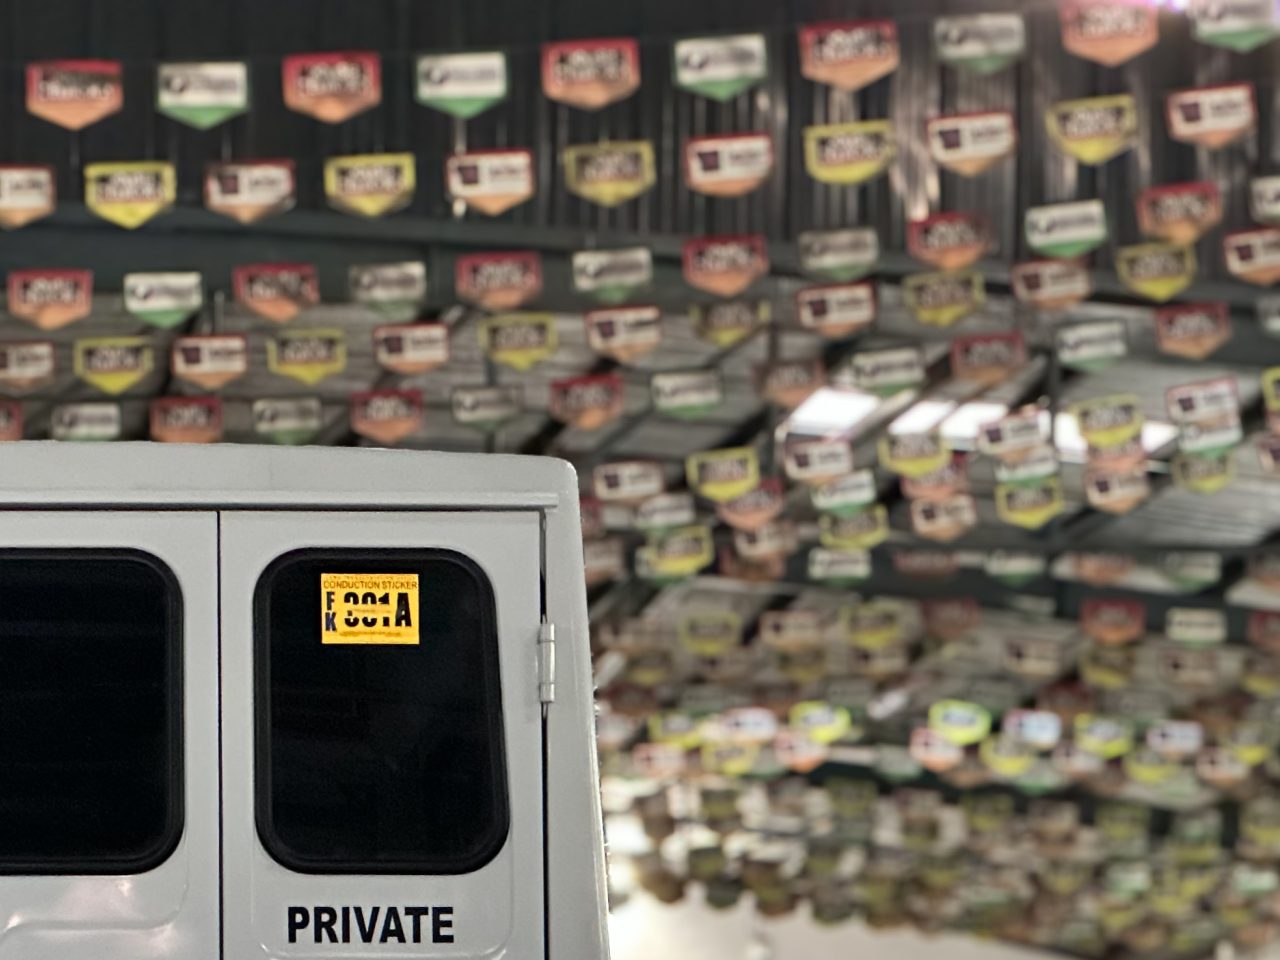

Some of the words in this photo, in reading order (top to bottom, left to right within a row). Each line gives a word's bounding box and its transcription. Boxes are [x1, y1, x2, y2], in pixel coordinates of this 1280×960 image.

[323, 580, 380, 590] CONDUCTION
[382, 580, 418, 590] STICKER
[288, 906, 455, 943] PRIVATE
